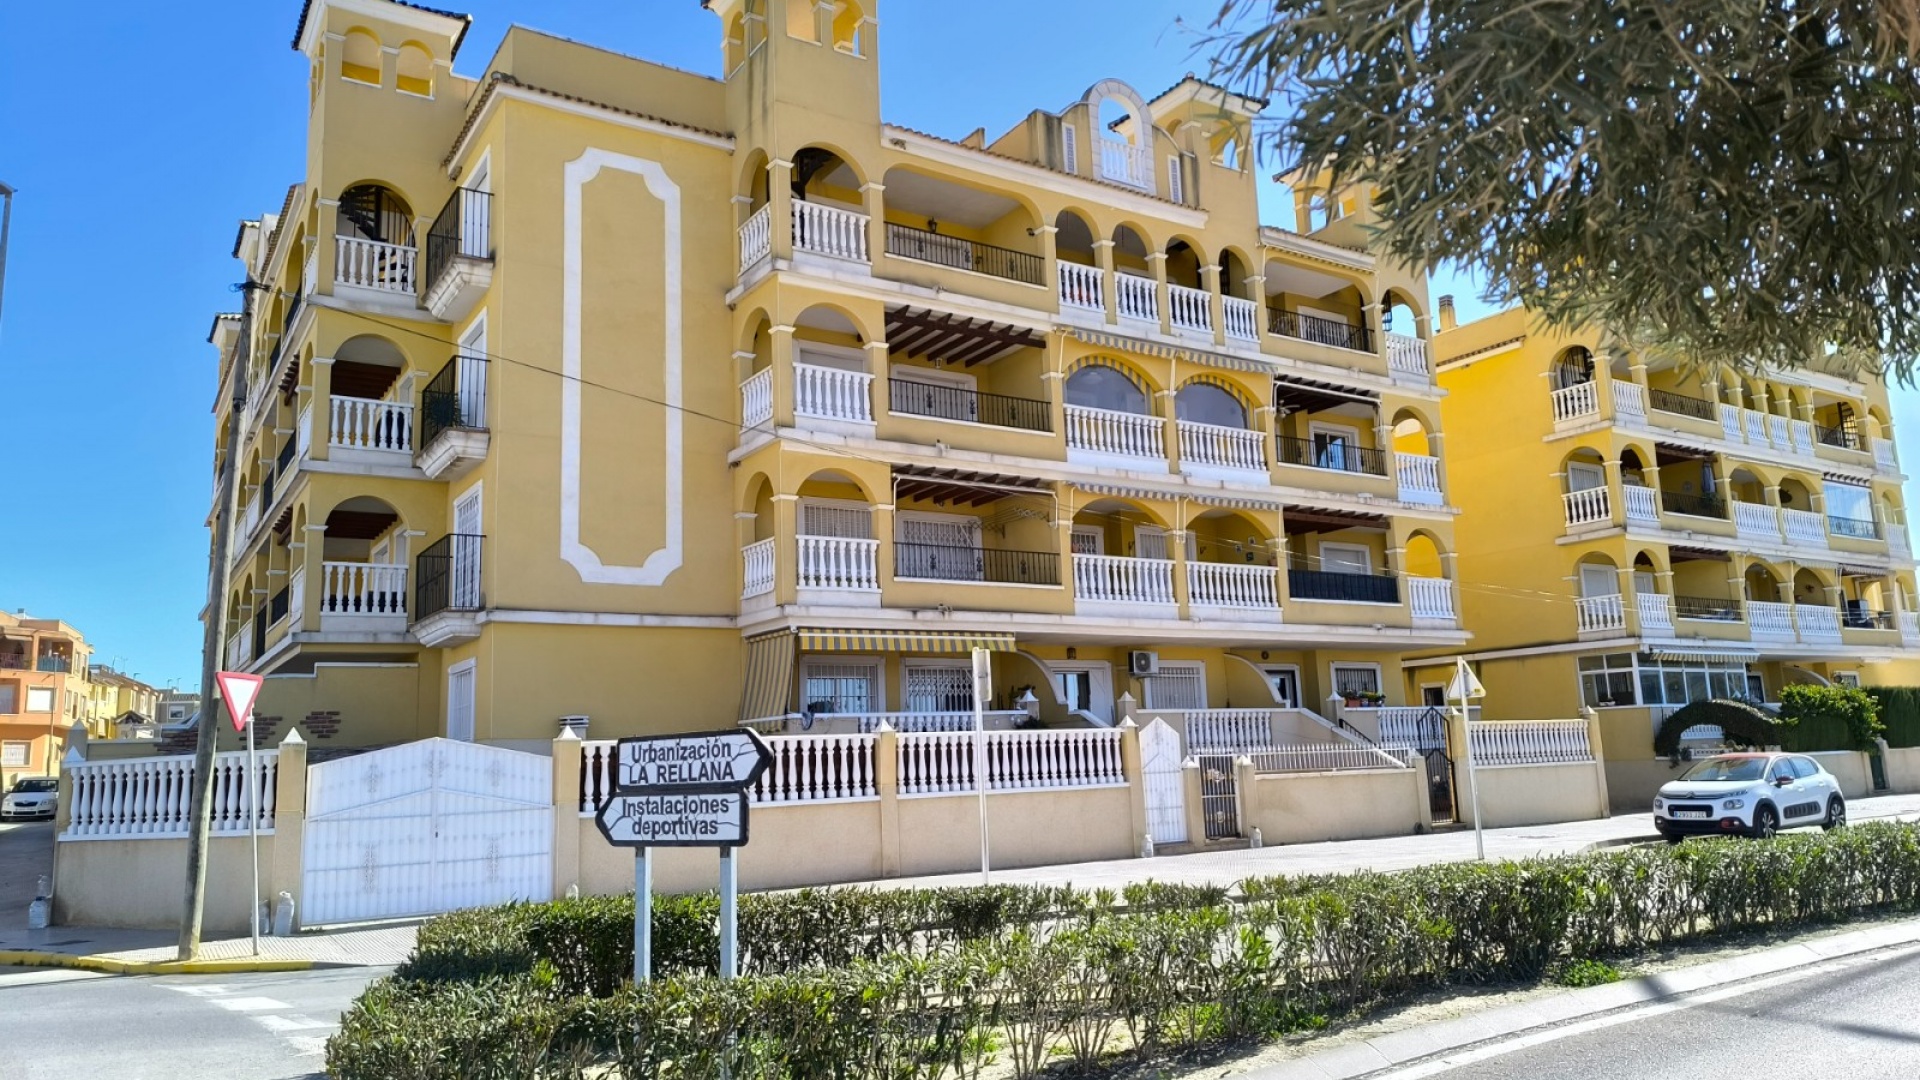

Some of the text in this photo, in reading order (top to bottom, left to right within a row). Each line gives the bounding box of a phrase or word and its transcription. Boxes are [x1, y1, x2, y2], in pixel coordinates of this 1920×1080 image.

[631, 738, 732, 763] Urbanización
[629, 761, 735, 784] LA RELLANA
[622, 796, 729, 817] Instalaciones
[632, 816, 718, 838] deportivas
